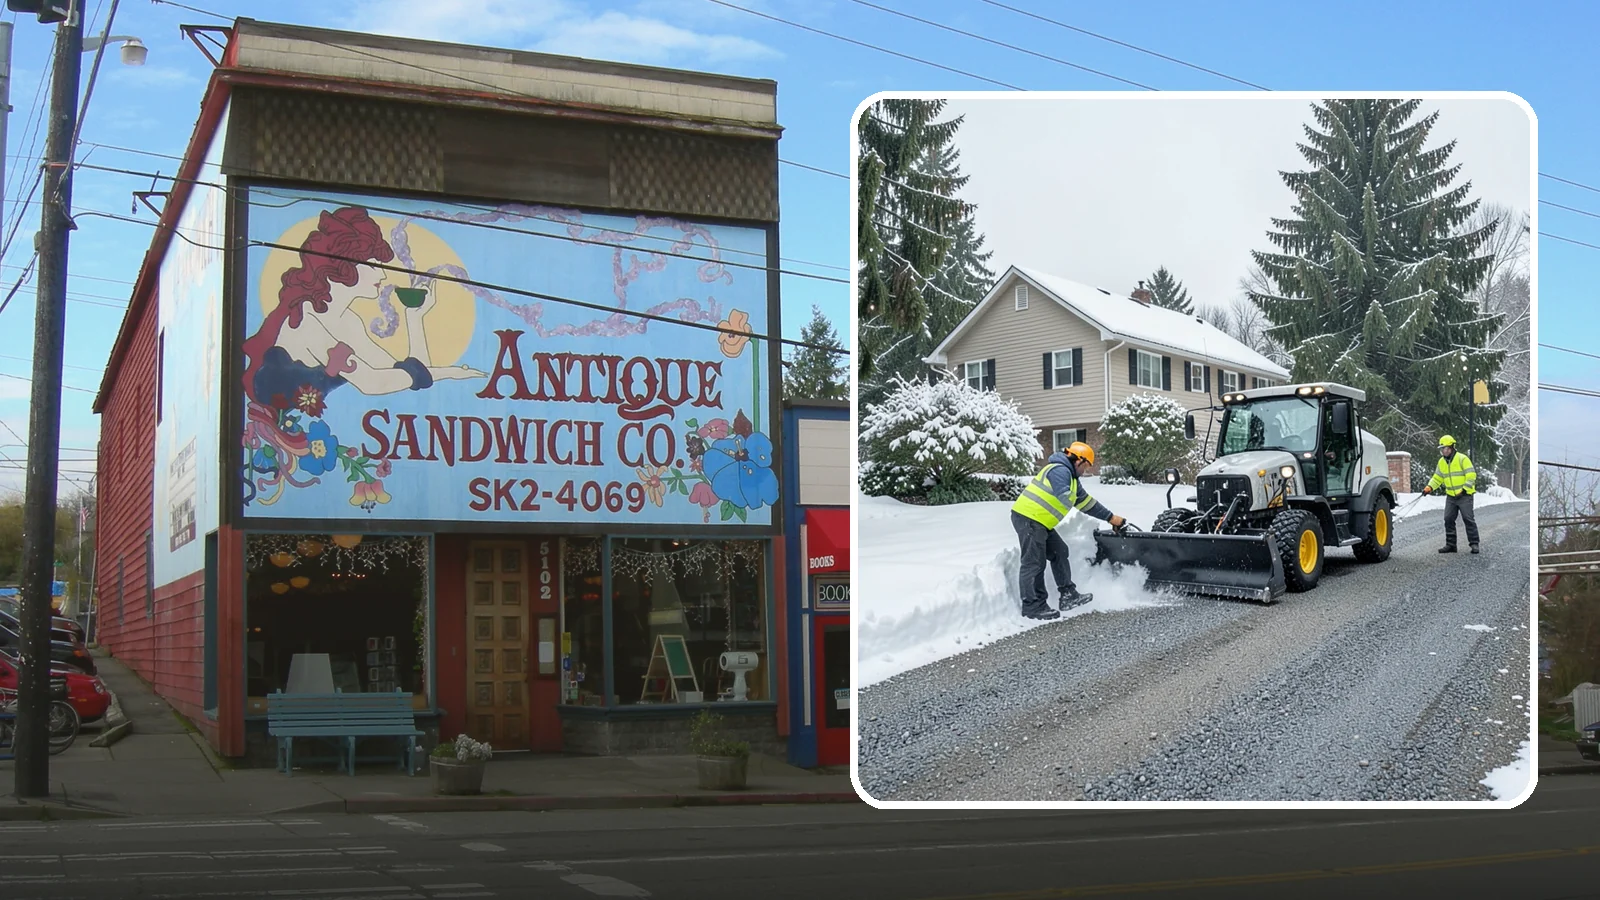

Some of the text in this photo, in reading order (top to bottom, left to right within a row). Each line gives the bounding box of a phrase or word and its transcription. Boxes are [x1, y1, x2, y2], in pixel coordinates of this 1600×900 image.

[476, 328, 723, 420] ANTIQUE
[362, 409, 685, 468] SANDWICH CO.
[468, 477, 646, 513] SK2-4069
[539, 541, 552, 599] 5102
[809, 555, 835, 569] BOOKS
